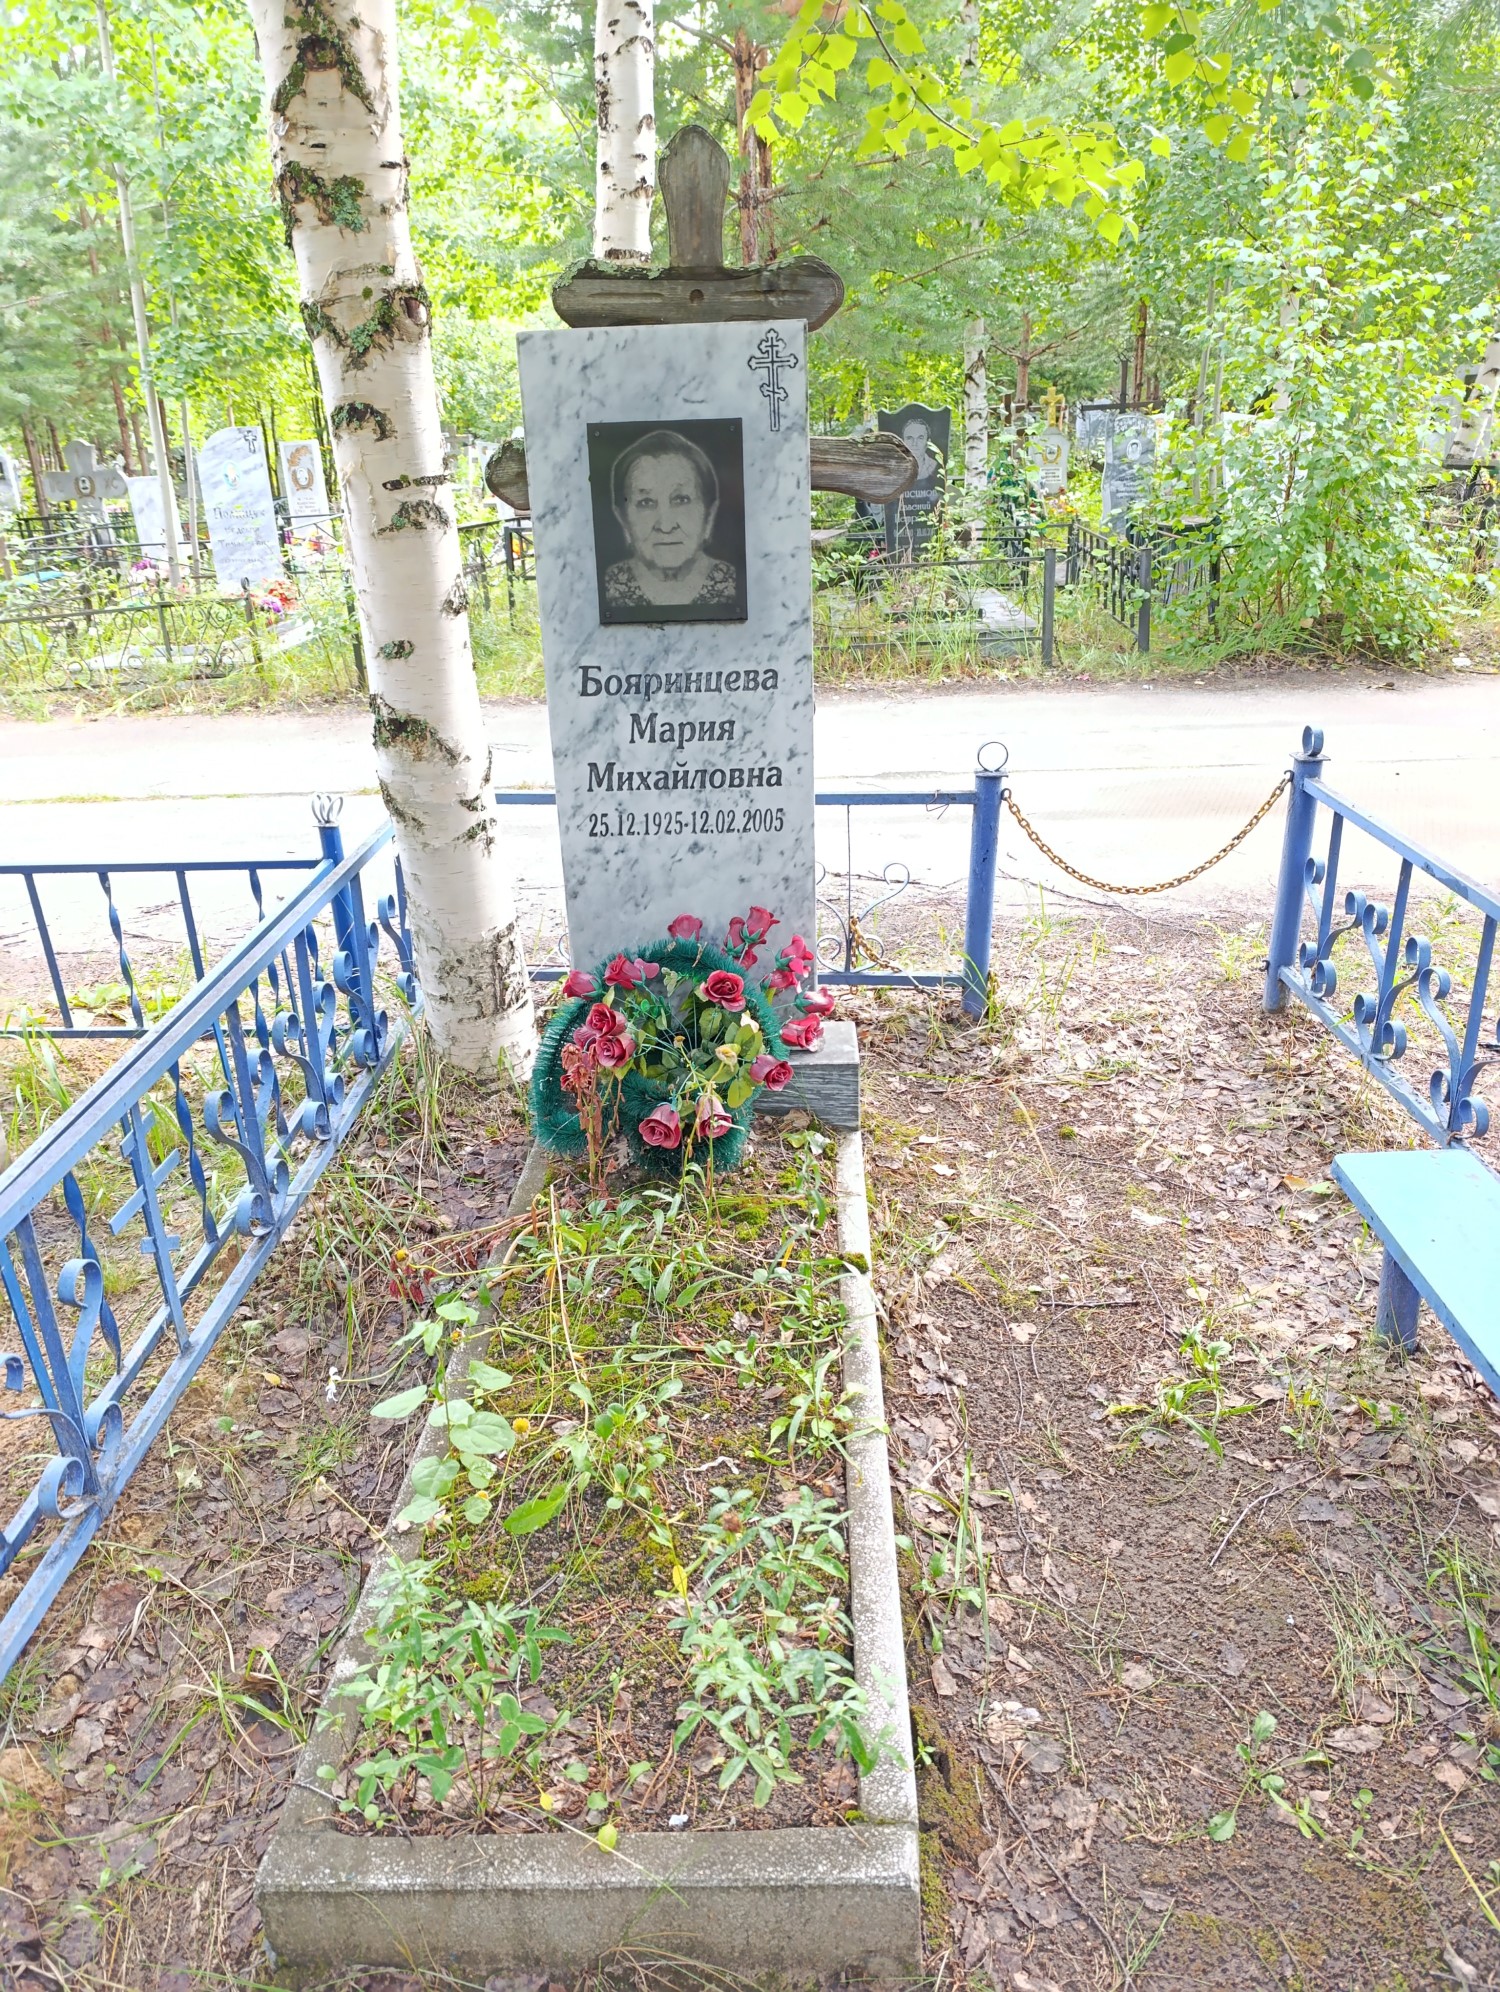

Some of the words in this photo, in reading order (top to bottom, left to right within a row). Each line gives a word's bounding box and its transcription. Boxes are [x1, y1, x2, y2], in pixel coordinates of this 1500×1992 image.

[579, 665, 779, 701] Бояринцева
[629, 712, 736, 749] Мария
[587, 760, 783, 792] Михайловна
[588, 807, 785, 837] 25.12.1925-12.02.2005
